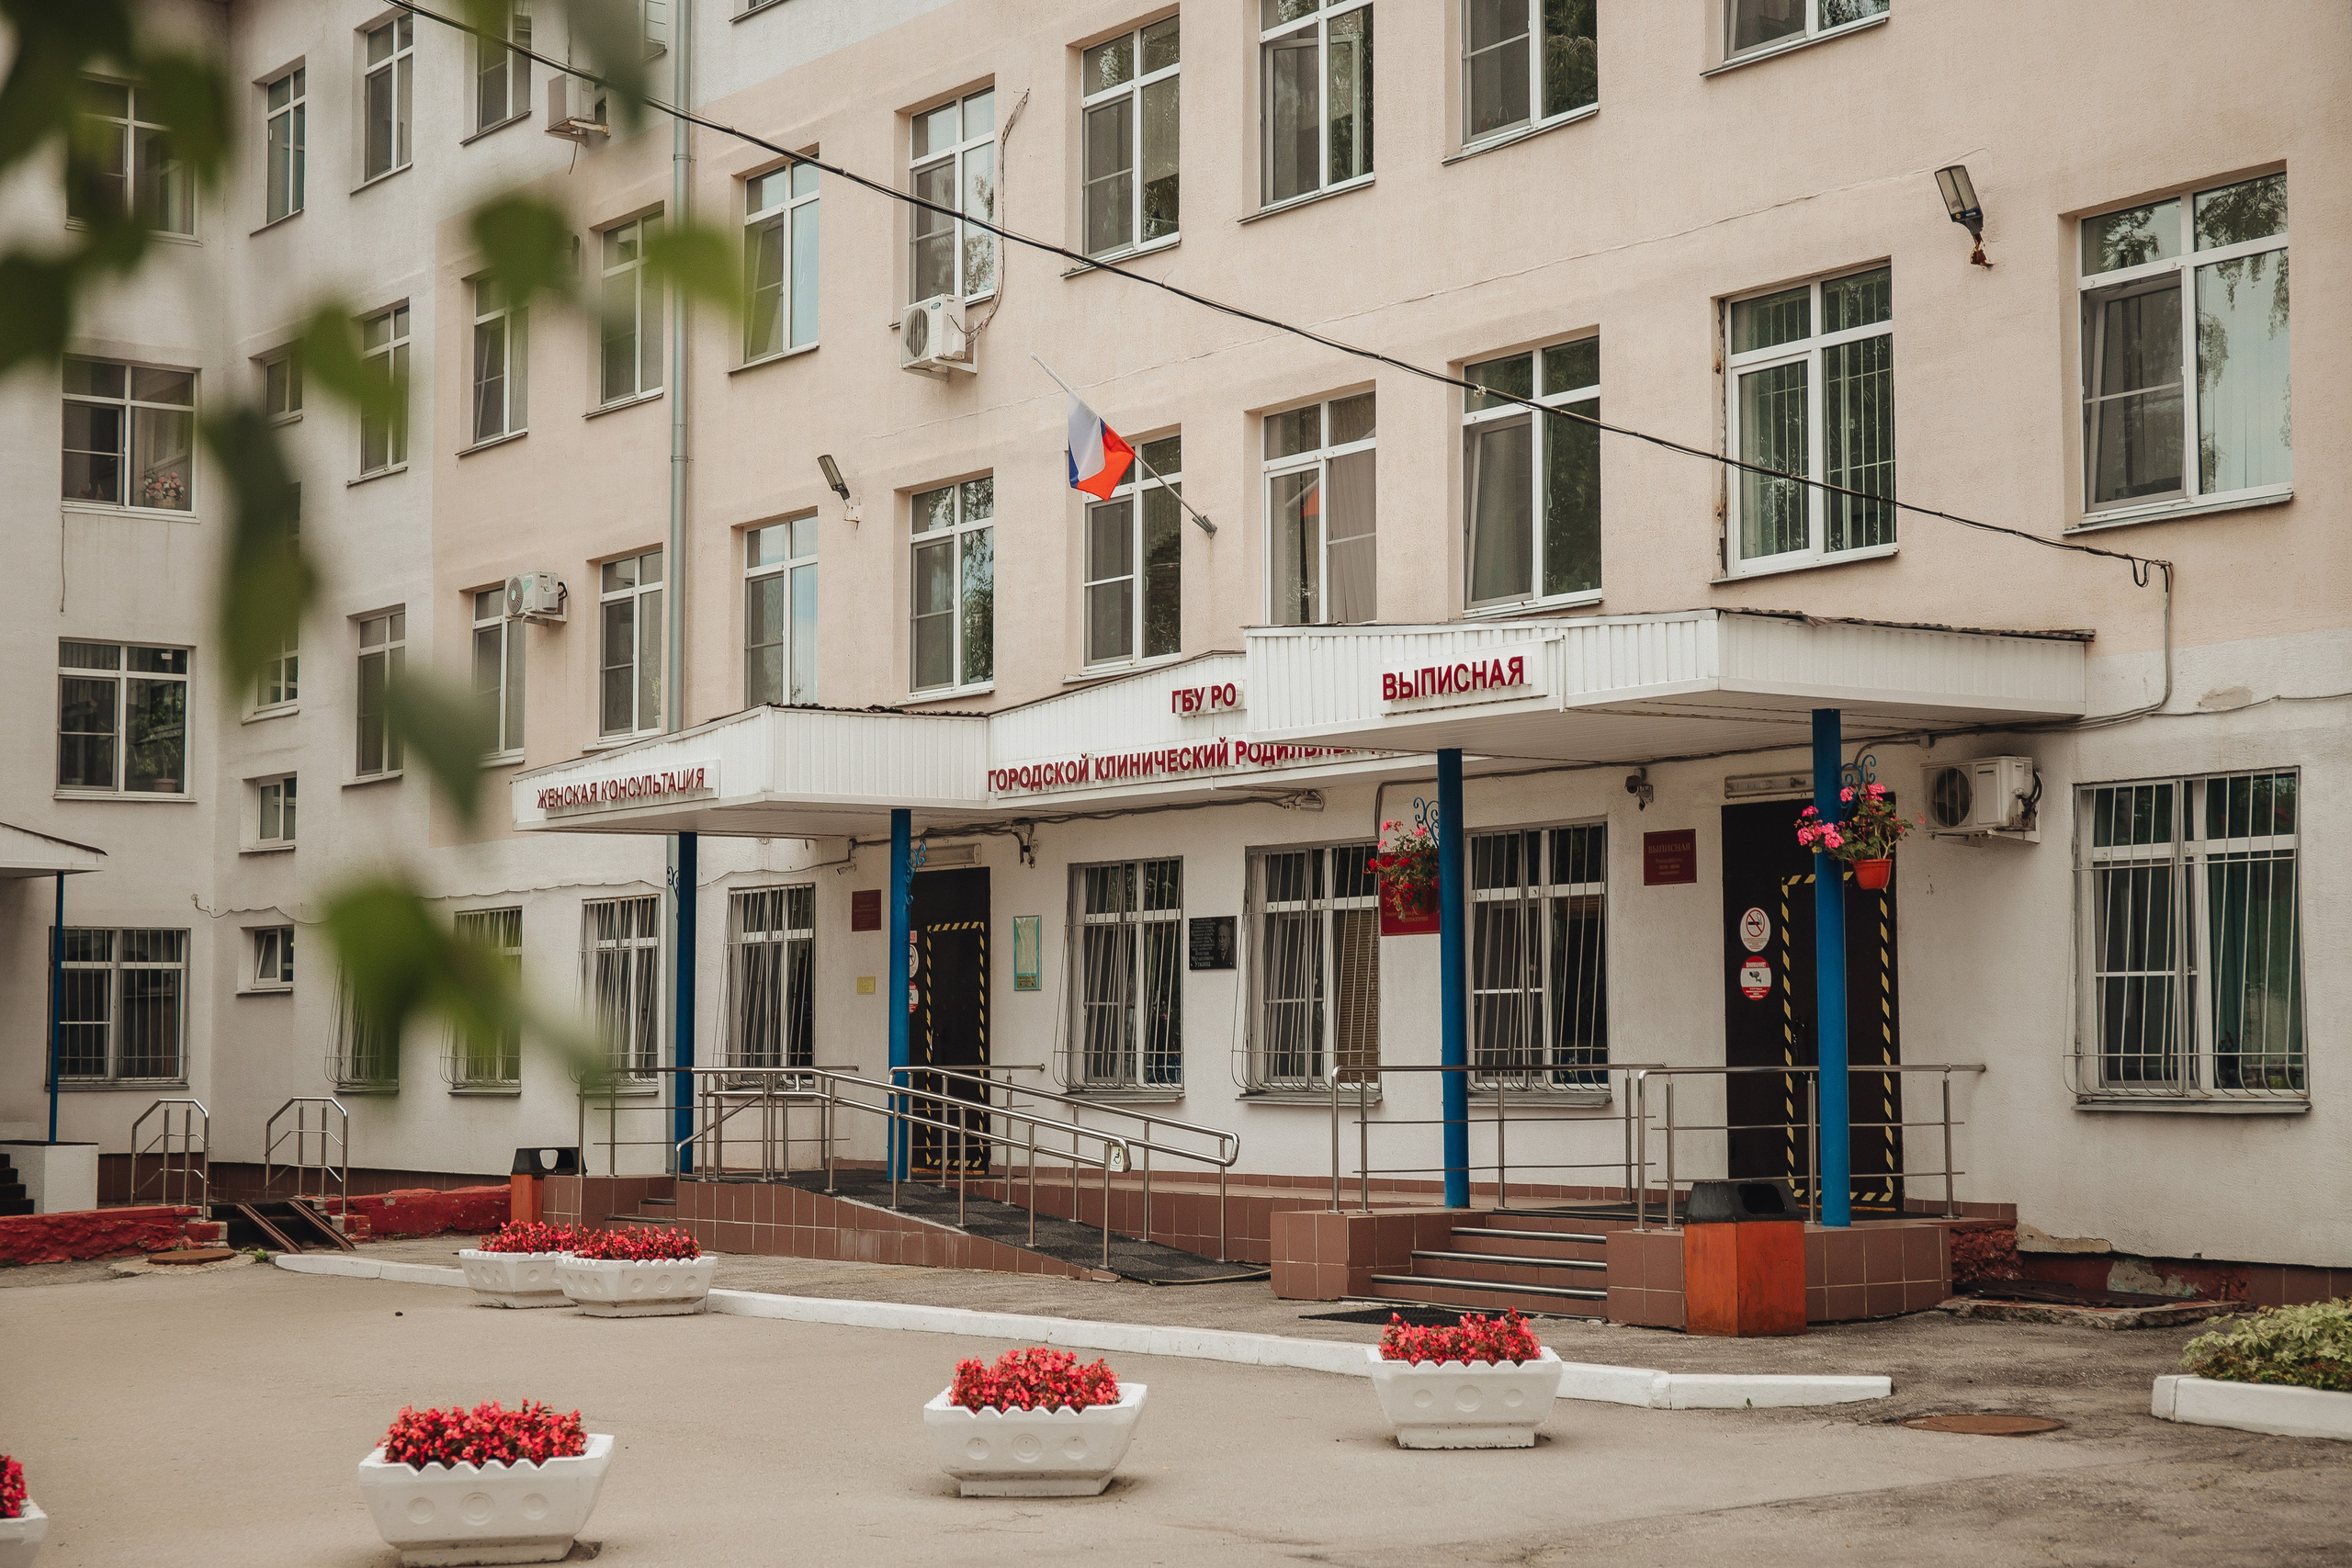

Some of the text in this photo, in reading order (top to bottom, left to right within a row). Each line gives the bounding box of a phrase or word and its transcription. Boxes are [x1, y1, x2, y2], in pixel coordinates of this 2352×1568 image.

[1172, 682, 1237, 714] ГБУ РО
[1383, 656, 1524, 702] ВЫПИСНАЯ
[989, 753, 1090, 792] ГОРОДСКОЙ
[1094, 737, 1228, 780] КЛИНИЧЕСКИЙ
[537, 767, 705, 808] ЖЕНСКАЯ КОНСУЛЬТАЦИЯ
[1647, 842, 1690, 854] ВЫПИСНАЯ
